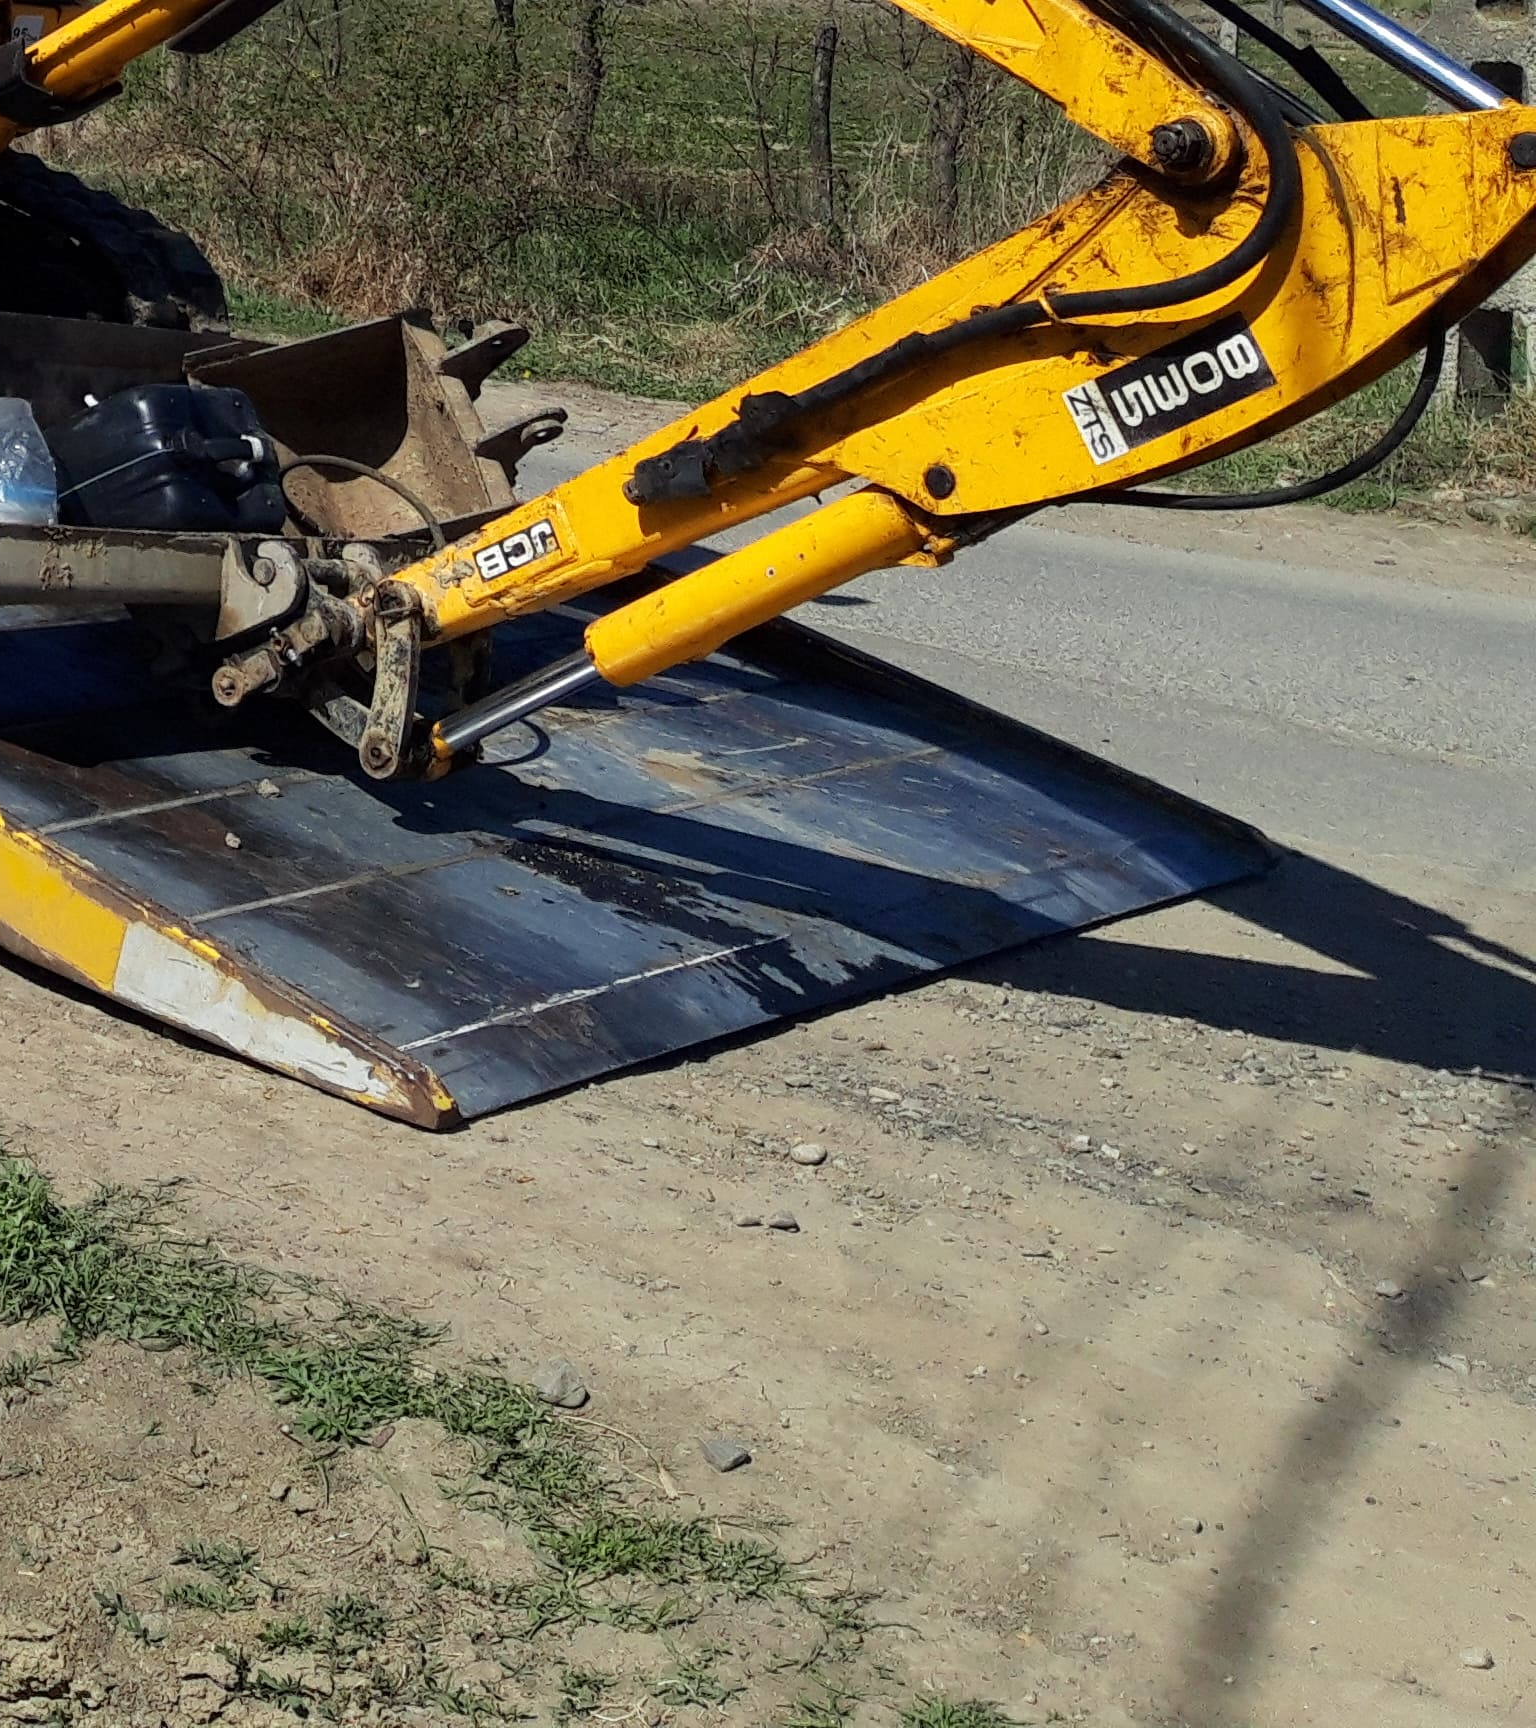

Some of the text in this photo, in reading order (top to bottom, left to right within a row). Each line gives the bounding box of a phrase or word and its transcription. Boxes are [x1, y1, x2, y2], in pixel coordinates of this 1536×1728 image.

[1110, 333, 1260, 427] 8035
[1066, 385, 1116, 459] ZTS
[475, 521, 558, 580] JCB
